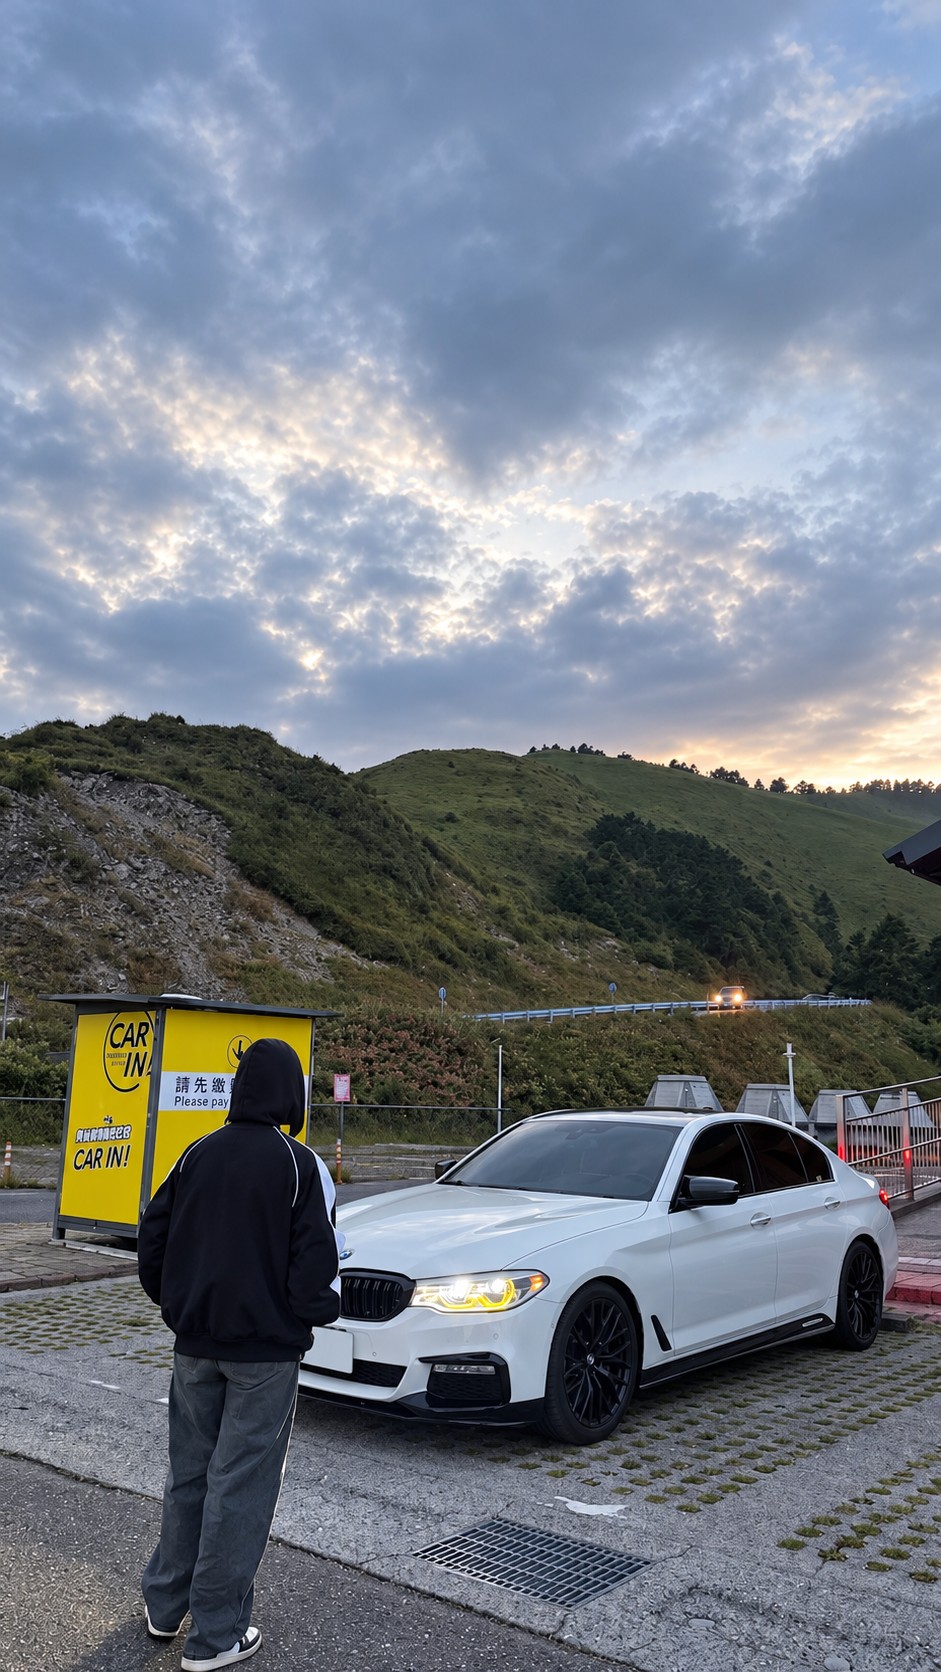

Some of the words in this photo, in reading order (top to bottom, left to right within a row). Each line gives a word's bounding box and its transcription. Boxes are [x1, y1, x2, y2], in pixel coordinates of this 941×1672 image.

[110, 1022, 149, 1048] CAR
[174, 1096, 209, 1107] Please
[211, 1098, 229, 1109] pay
[73, 1147, 103, 1170] CAR
[105, 1144, 130, 1168] IN!
